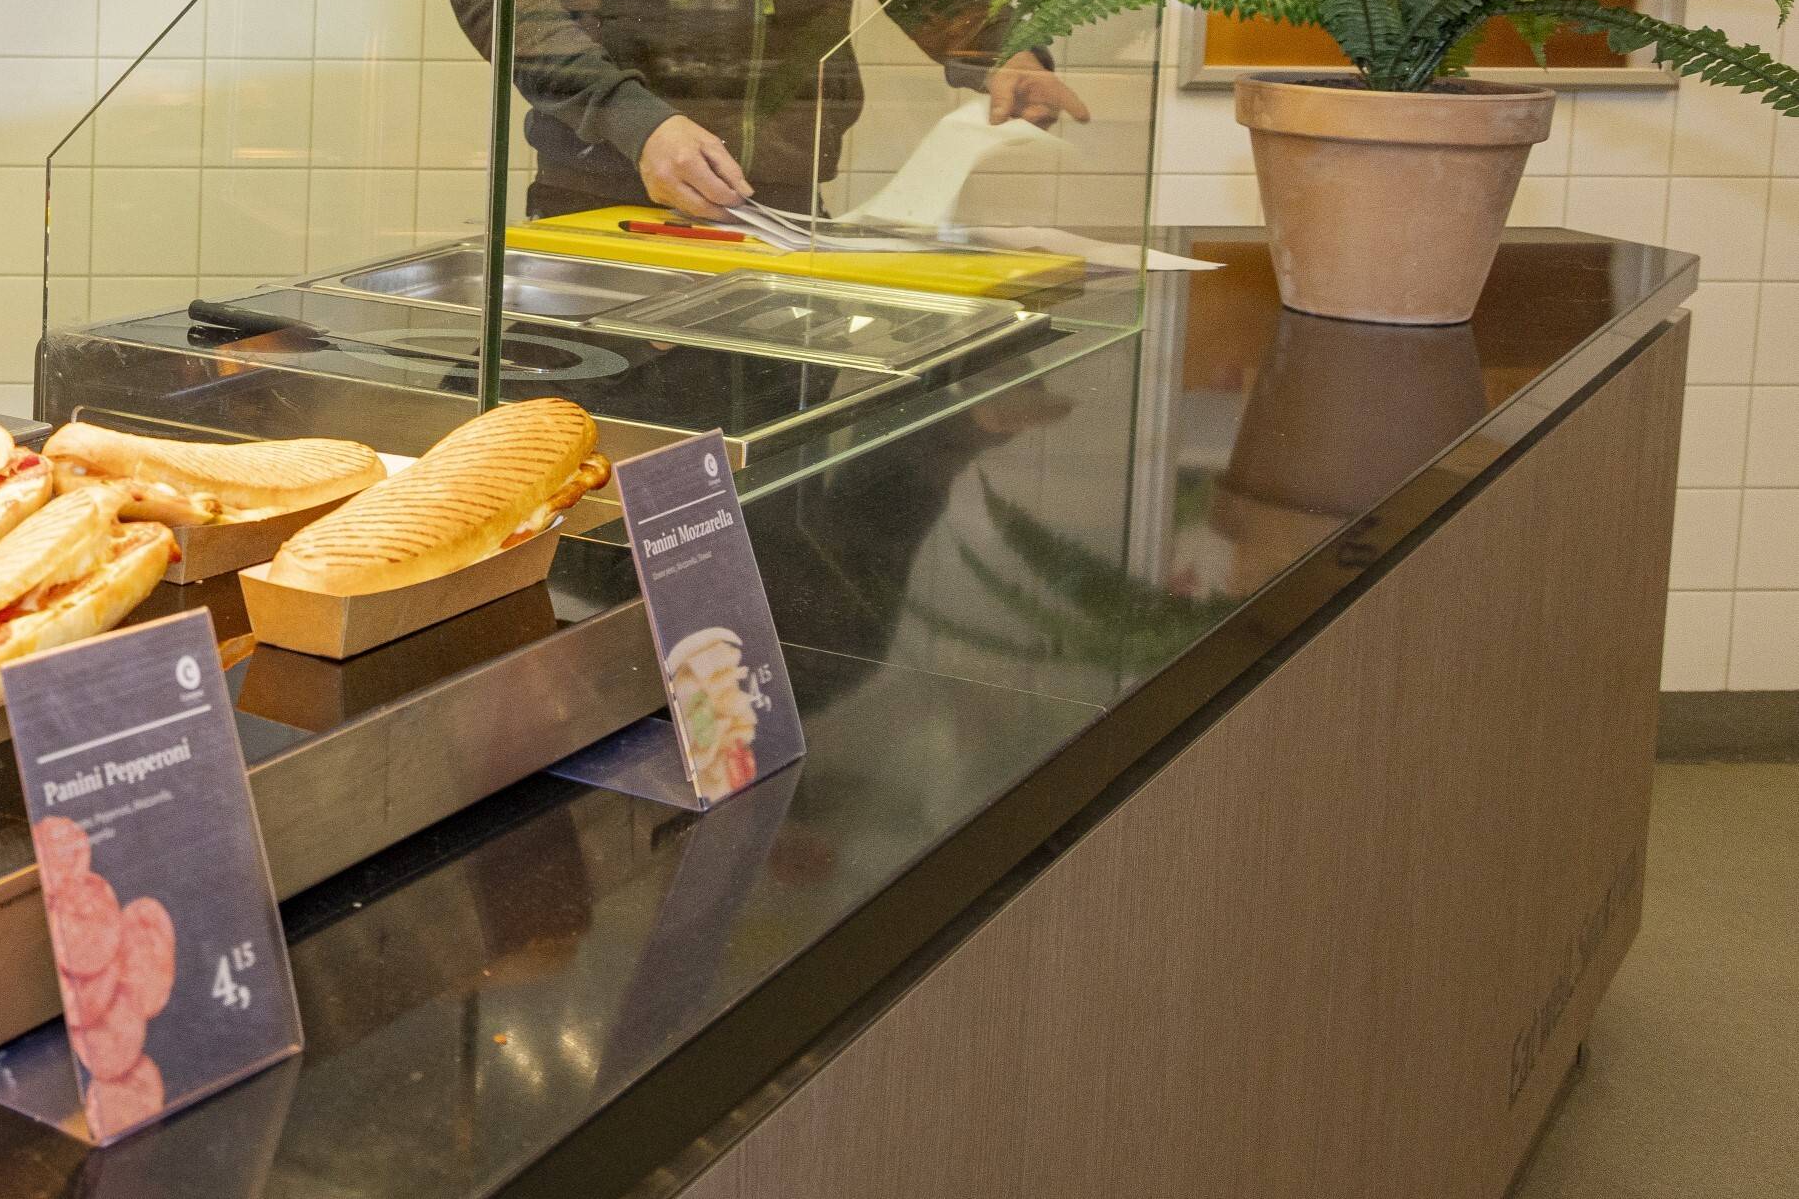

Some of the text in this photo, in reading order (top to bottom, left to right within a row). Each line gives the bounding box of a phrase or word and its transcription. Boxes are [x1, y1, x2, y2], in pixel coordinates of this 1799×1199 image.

[643, 509, 734, 558] Panini Mozzarella
[43, 736, 193, 807] Panini Pepperoni
